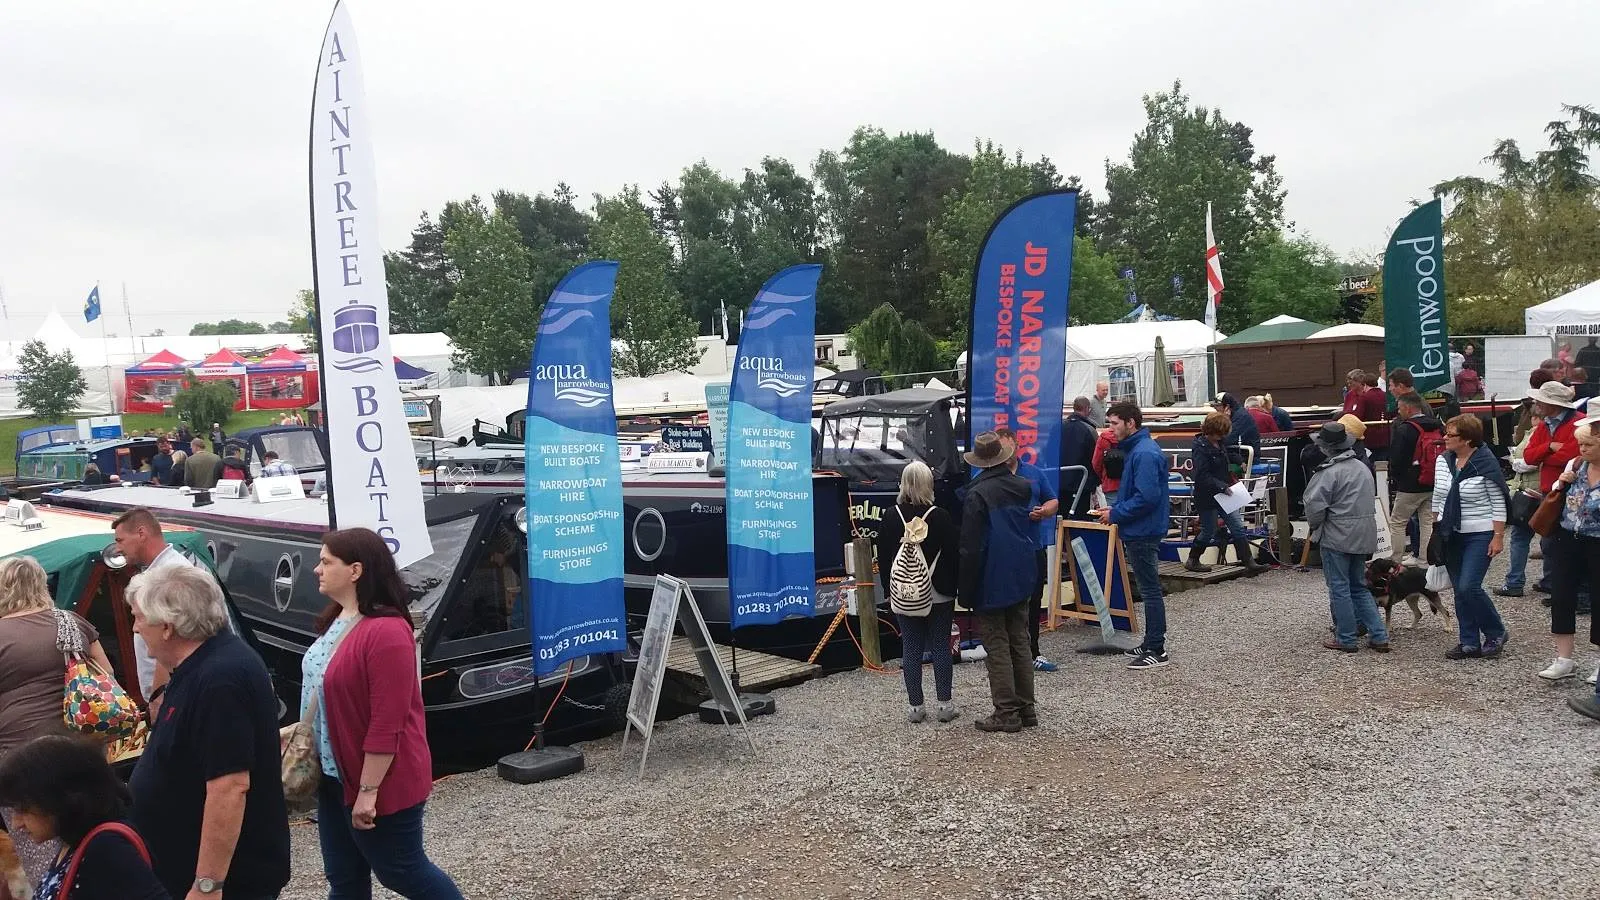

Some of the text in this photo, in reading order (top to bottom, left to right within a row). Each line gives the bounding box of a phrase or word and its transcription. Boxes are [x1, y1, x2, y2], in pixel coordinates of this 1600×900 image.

[327, 31, 362, 287] AINTREE
[1024, 240, 1048, 277] JD
[996, 264, 1016, 348] BESPOKE
[1396, 235, 1445, 378] fernwood
[1556, 324, 1587, 335] BRAIDBAR
[740, 356, 784, 385] aqua
[536, 364, 587, 397] aqua
[558, 379, 610, 389] narrowboats
[994, 357, 1012, 405] BOAT
[667, 428, 703, 438] Stoke-on-Trent
[742, 427, 760, 436] NEW
[541, 443, 605, 454] NEW BESPOKE
[682, 438, 703, 451] Building
[745, 439, 767, 448] BUILT
[544, 456, 601, 467] BUILT BOATS
[667, 459, 693, 468] MARINE
[352, 385, 400, 555] BOATS
[540, 478, 607, 490] NARROWBOAT
[560, 491, 585, 502] HIRE
[734, 488, 753, 498] BOAT
[533, 510, 620, 524] BOAT SPONSORSHIP
[555, 525, 596, 537] SCHEME
[543, 542, 608, 560] FURNISHINGS
[559, 558, 592, 571] STORE
[738, 602, 771, 616] 01283
[773, 595, 809, 612] 701041
[573, 629, 618, 647] 701041
